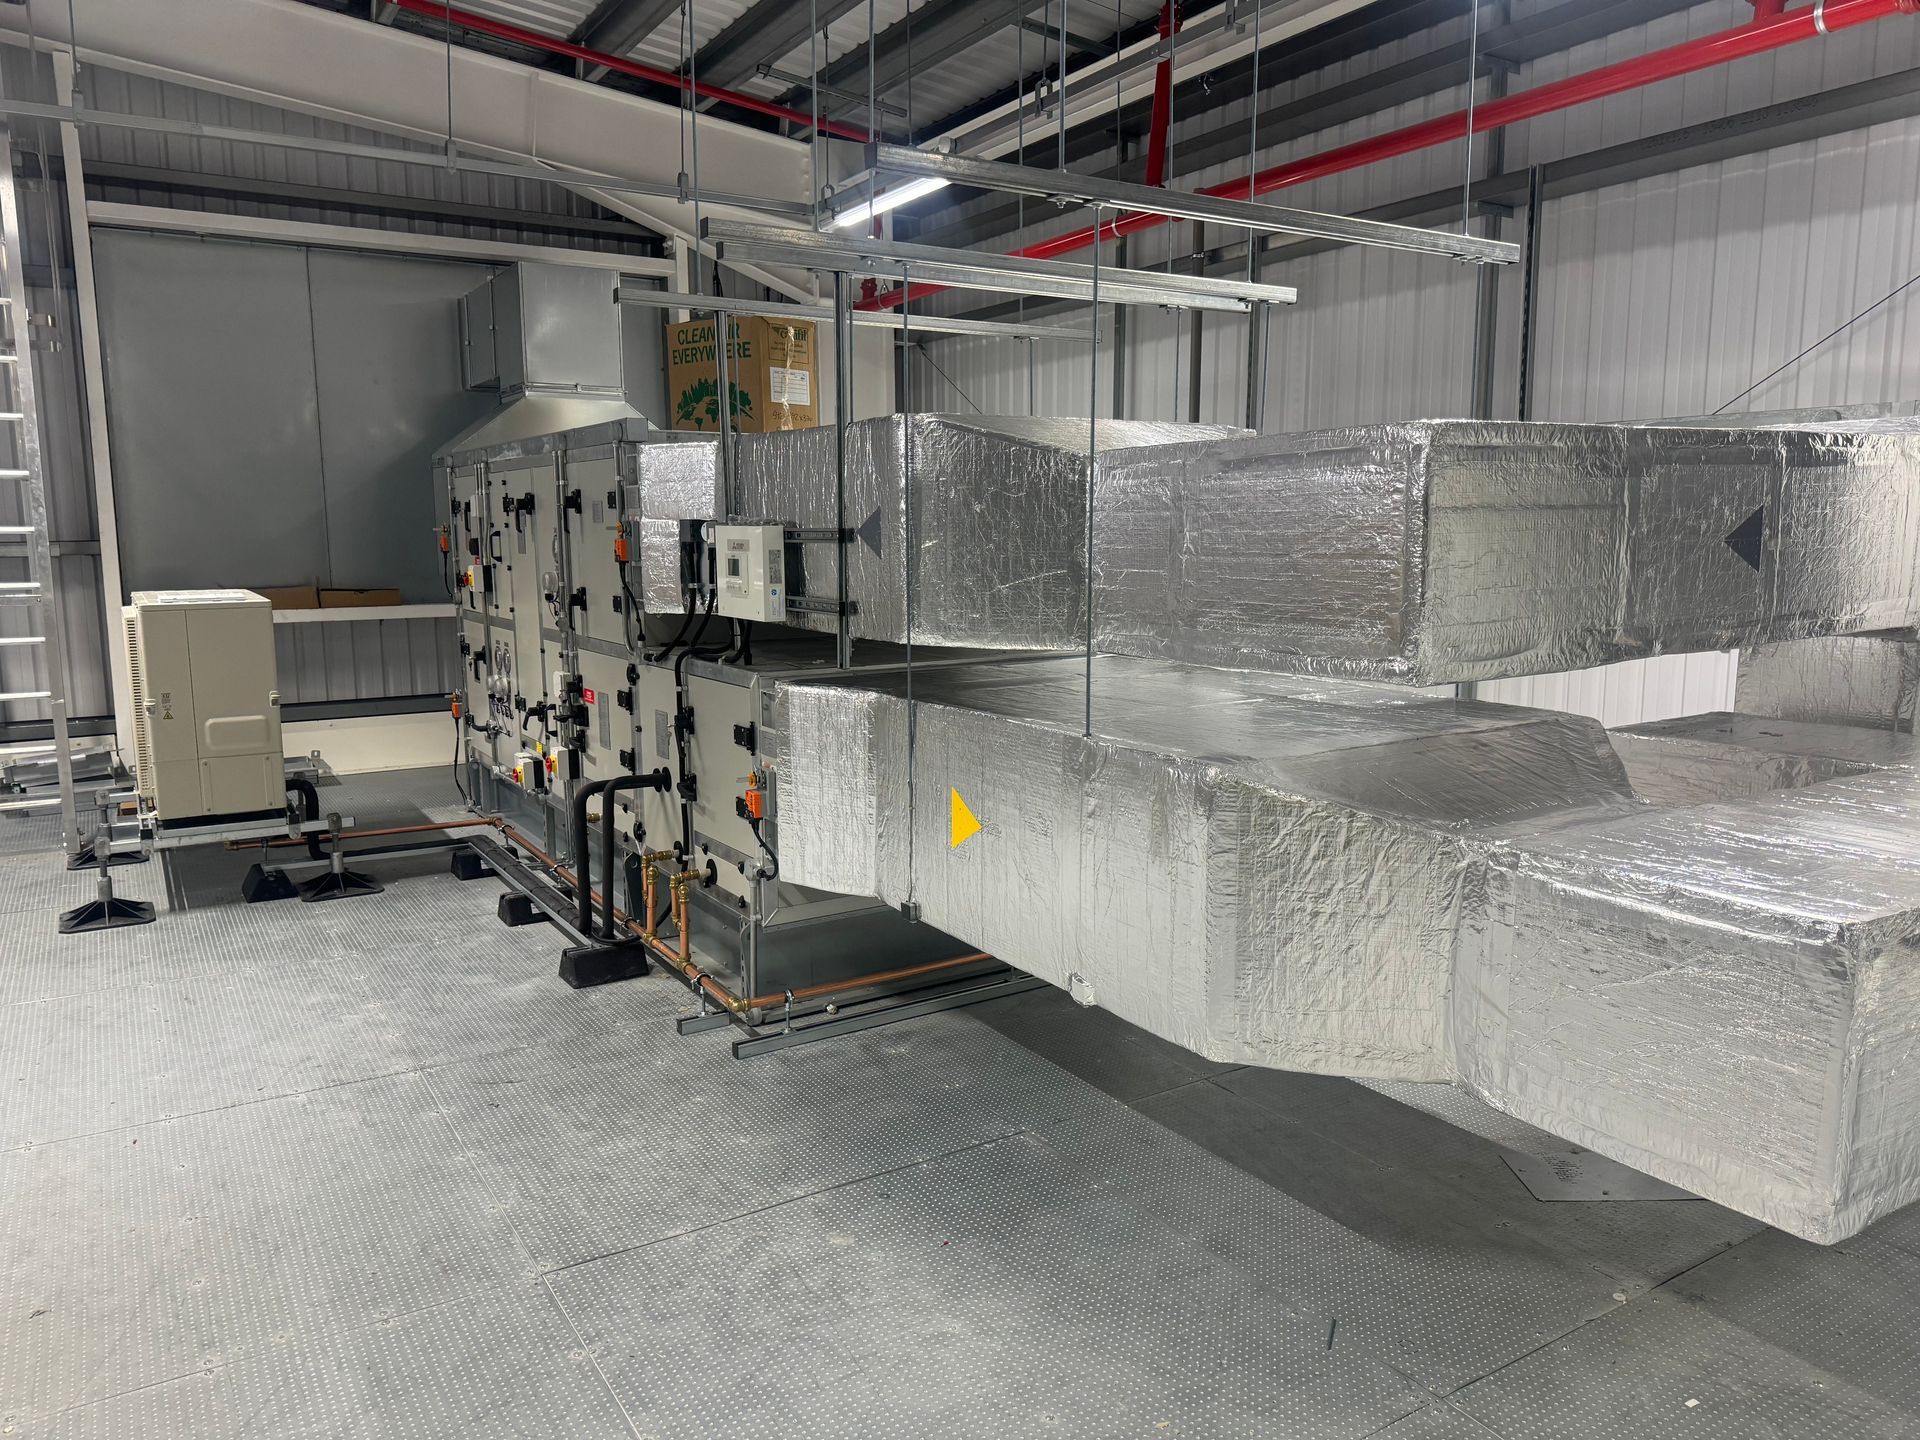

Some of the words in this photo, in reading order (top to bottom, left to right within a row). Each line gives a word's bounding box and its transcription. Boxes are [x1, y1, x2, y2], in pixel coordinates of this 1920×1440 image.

[677, 326, 715, 345] CLEAN
[724, 323, 740, 339] IR
[672, 341, 752, 365] EVERYWERE
